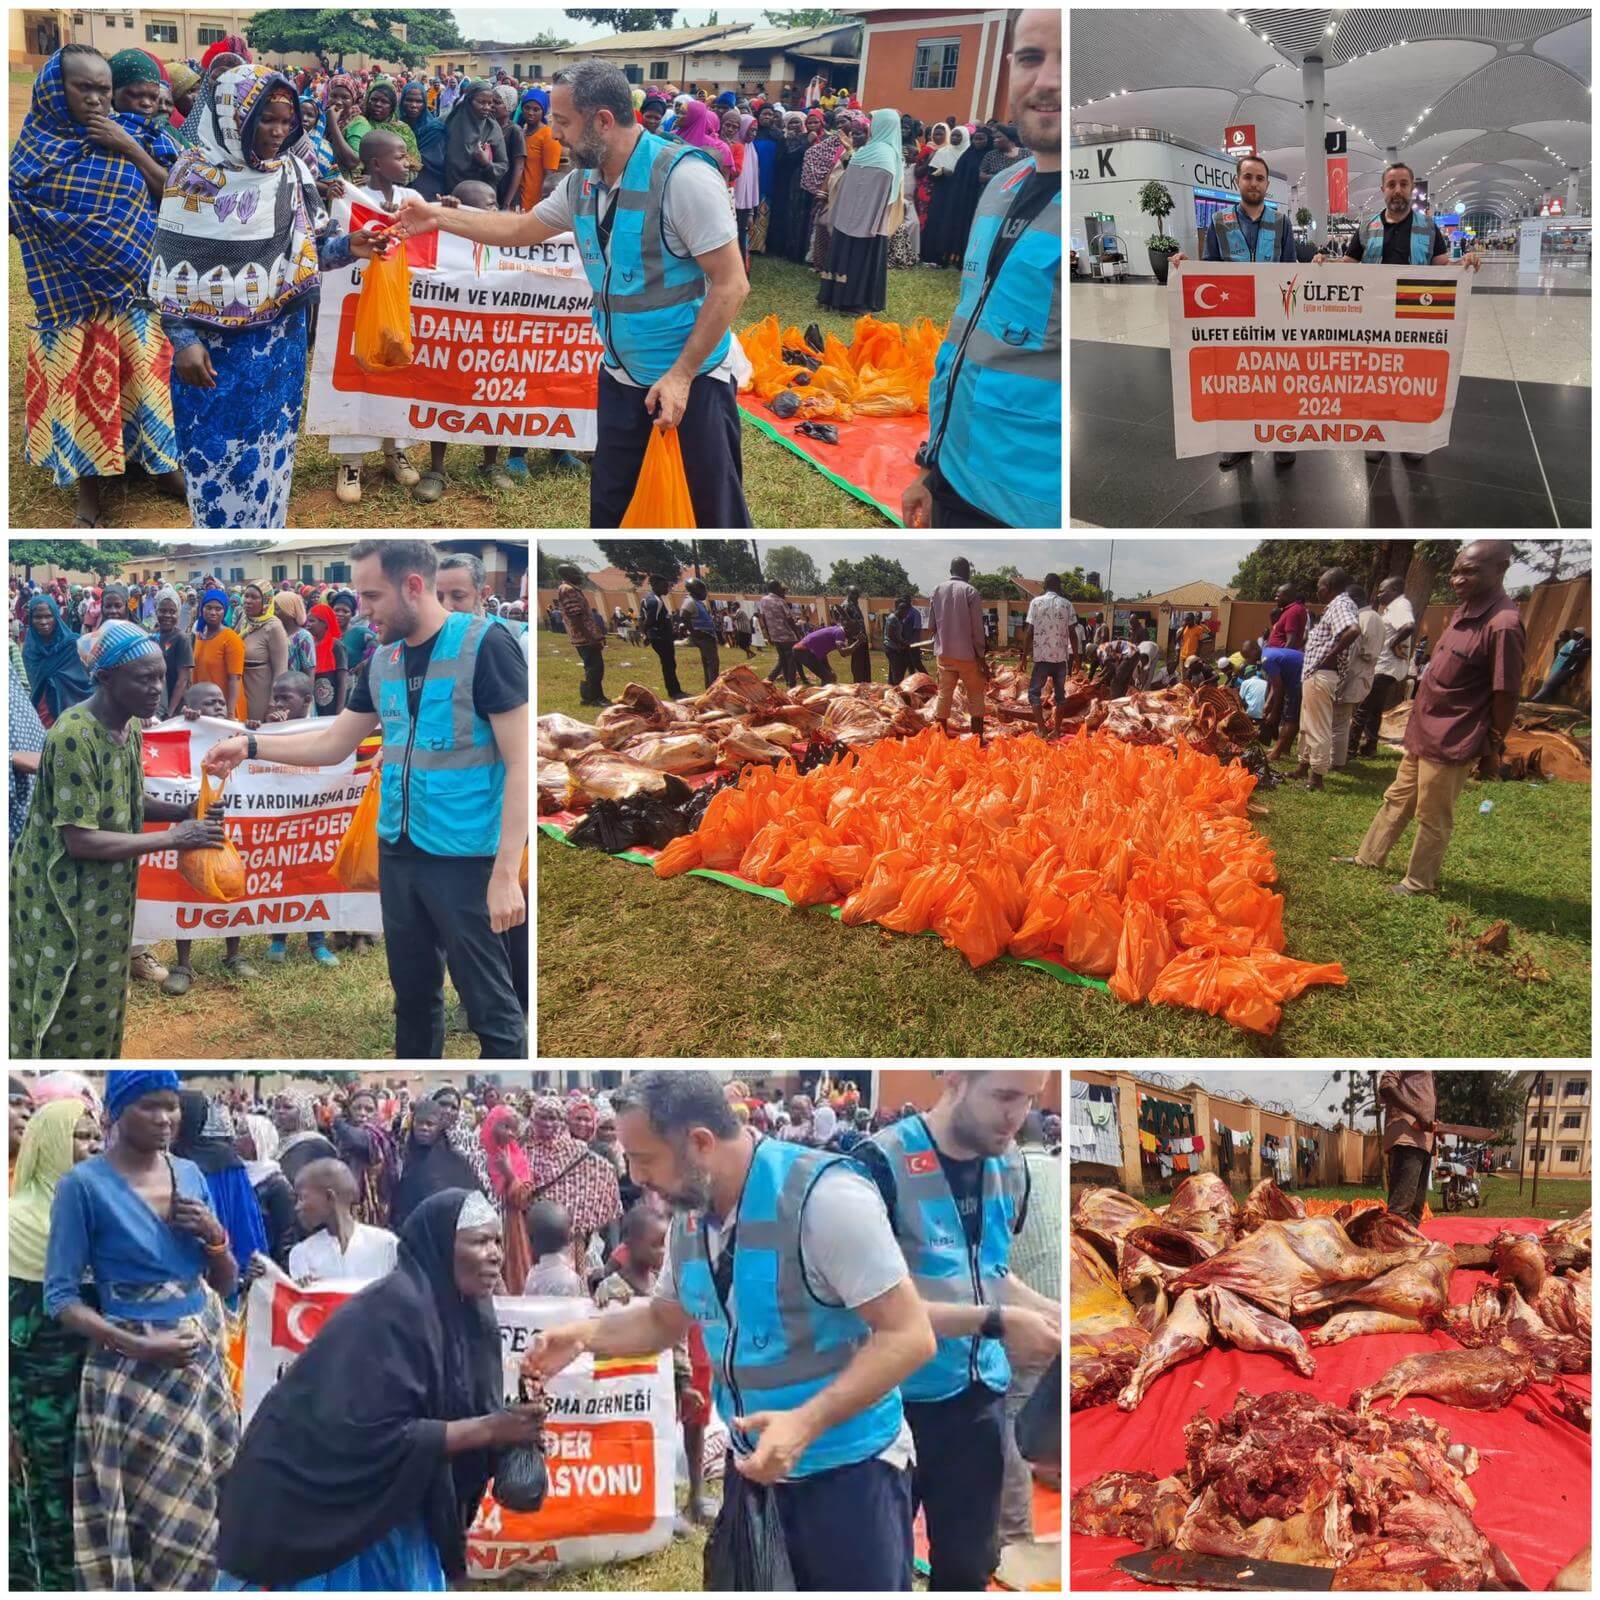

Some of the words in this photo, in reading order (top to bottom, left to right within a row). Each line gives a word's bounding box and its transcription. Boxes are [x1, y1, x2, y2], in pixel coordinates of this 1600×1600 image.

[1332, 132, 1340, 151] J
[1097, 147, 1117, 178] K
[409, 279, 458, 304] ĞİTİM
[468, 288, 487, 306] VE
[1303, 280, 1365, 302] ÜLFET
[1192, 328, 1229, 341] ÜLFET
[1233, 325, 1276, 341] EĞİTİM
[1282, 328, 1297, 341] VE
[1300, 328, 1392, 345] YARDIMLAŞMA
[1394, 328, 1448, 345] DERNEĞİ
[1236, 351, 1300, 371] ADANA
[472, 378, 527, 402] 2024
[1201, 375, 1277, 395] KURBAN
[1298, 396, 1342, 416] 2024
[408, 404, 576, 438] UGANDA
[1254, 423, 1386, 443] UGANDA
[249, 784, 343, 810] YARDIMLAŞMA
[246, 870, 284, 896] 024
[176, 899, 331, 930] UGANDA
[585, 1388, 651, 1415] DERNEĞİ
